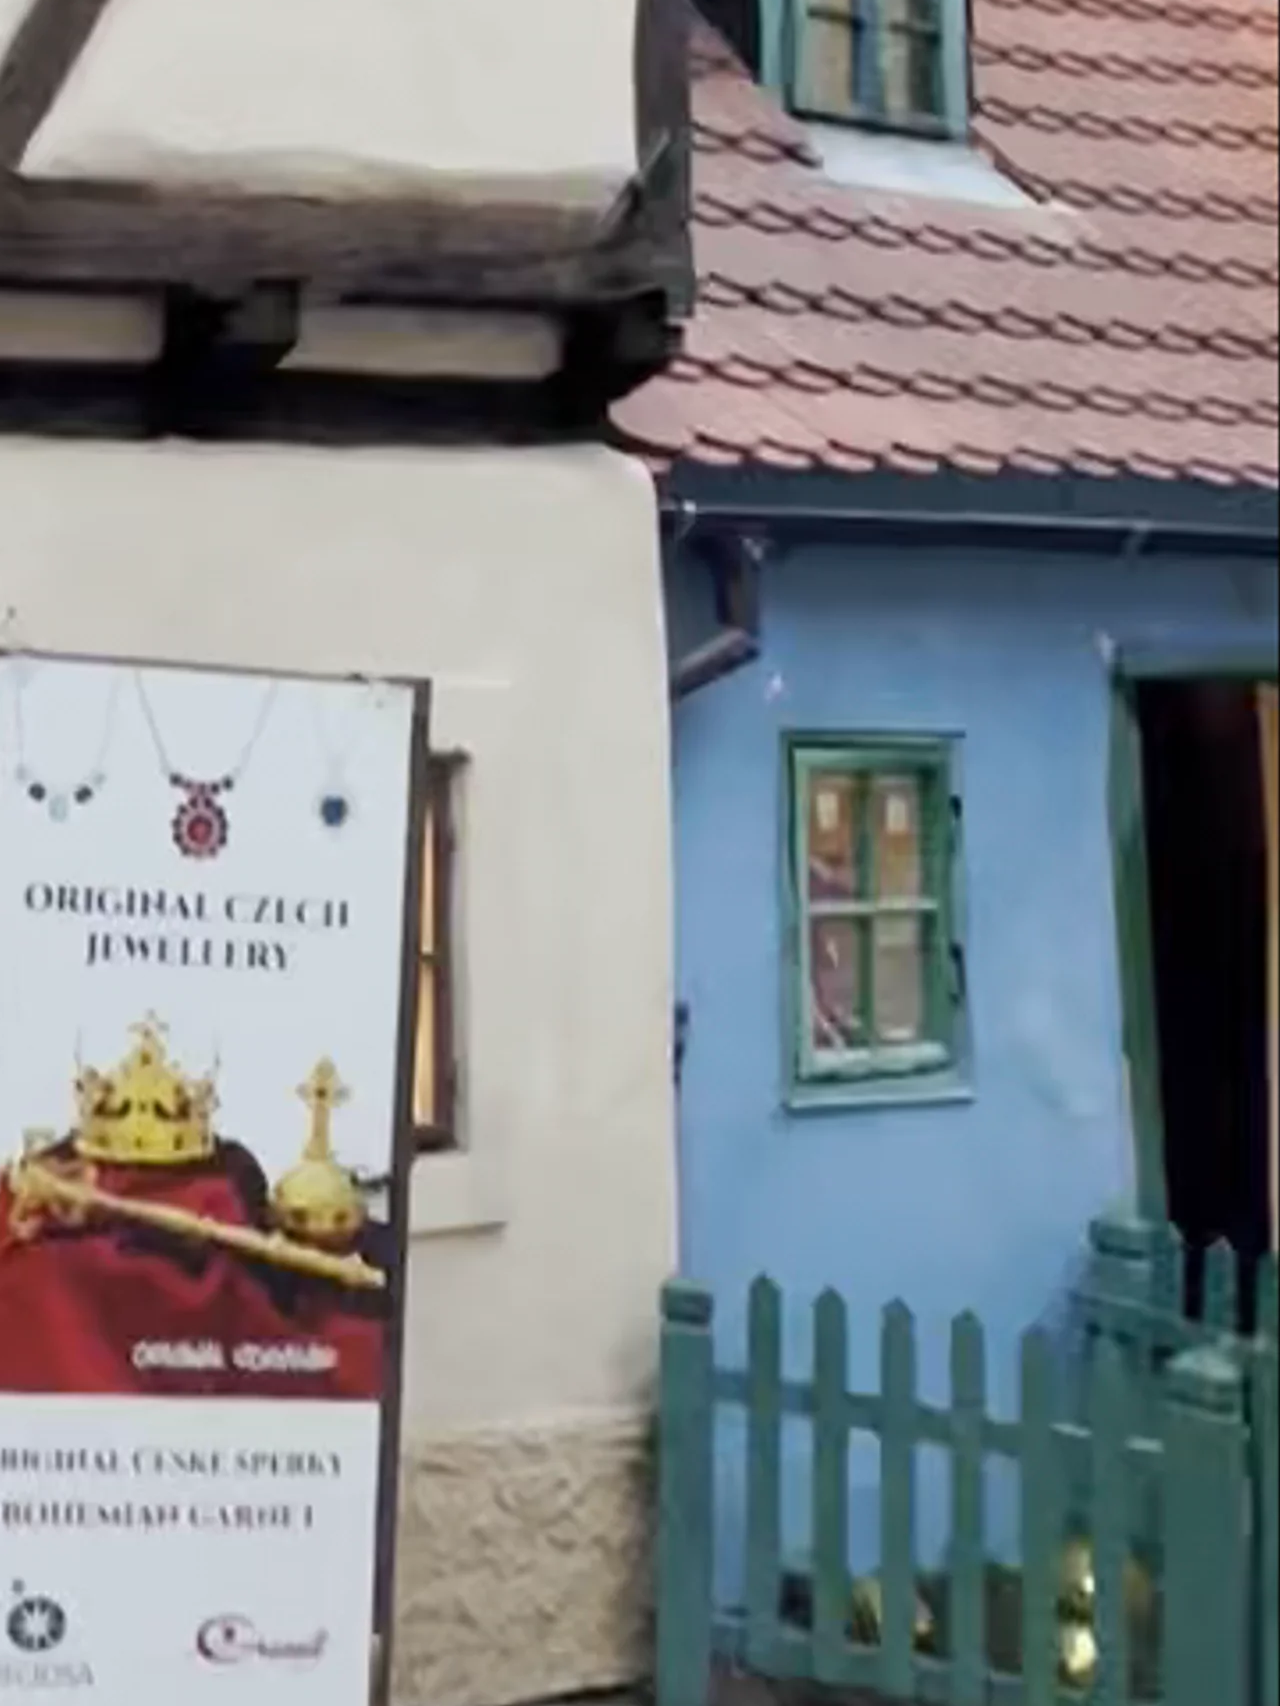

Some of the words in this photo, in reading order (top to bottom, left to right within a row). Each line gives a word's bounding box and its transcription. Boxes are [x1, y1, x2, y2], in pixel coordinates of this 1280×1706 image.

[24, 882, 210, 921] ORIGINAL
[225, 894, 350, 929] CZECH
[86, 932, 289, 971] JEWELLERY
[1, 1500, 179, 1528] BOHEMIAN
